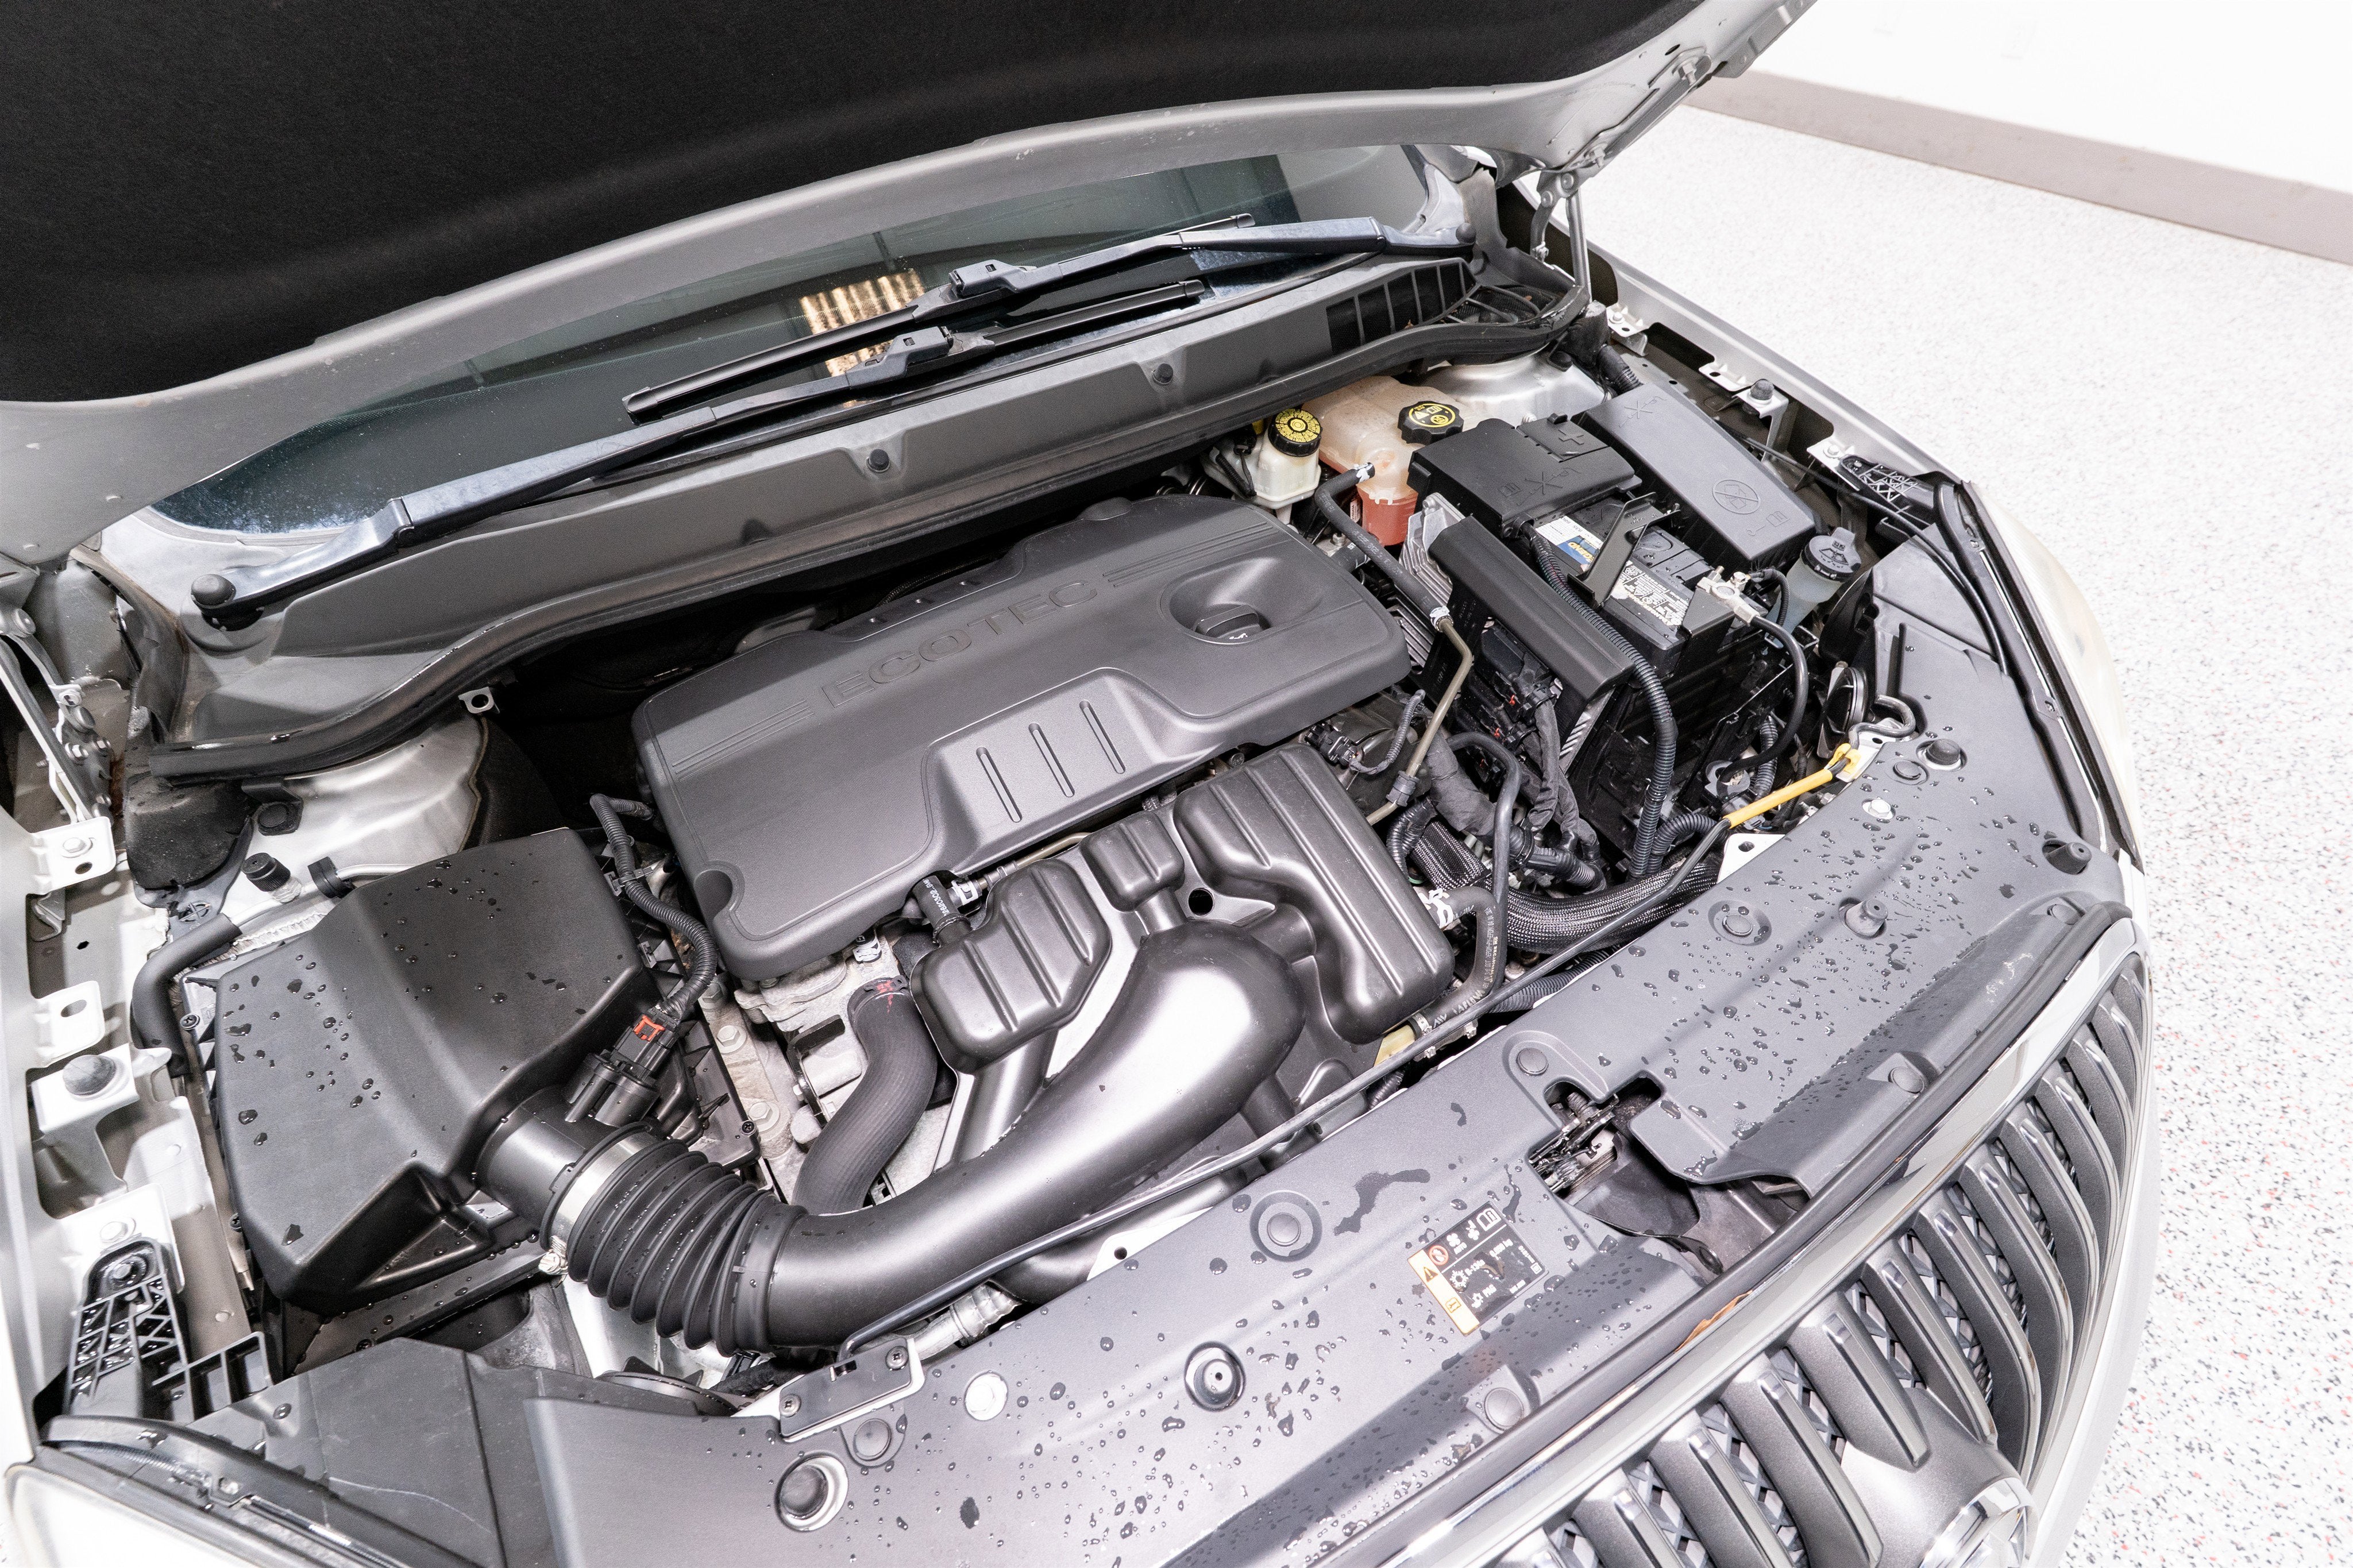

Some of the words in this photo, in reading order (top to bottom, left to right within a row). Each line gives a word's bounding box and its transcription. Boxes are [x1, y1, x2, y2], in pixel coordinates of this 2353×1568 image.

[821, 580, 1097, 708] ECOTEC
[1453, 1242, 1467, 1254] AUTO
[1482, 1284, 1497, 1297] PAG
